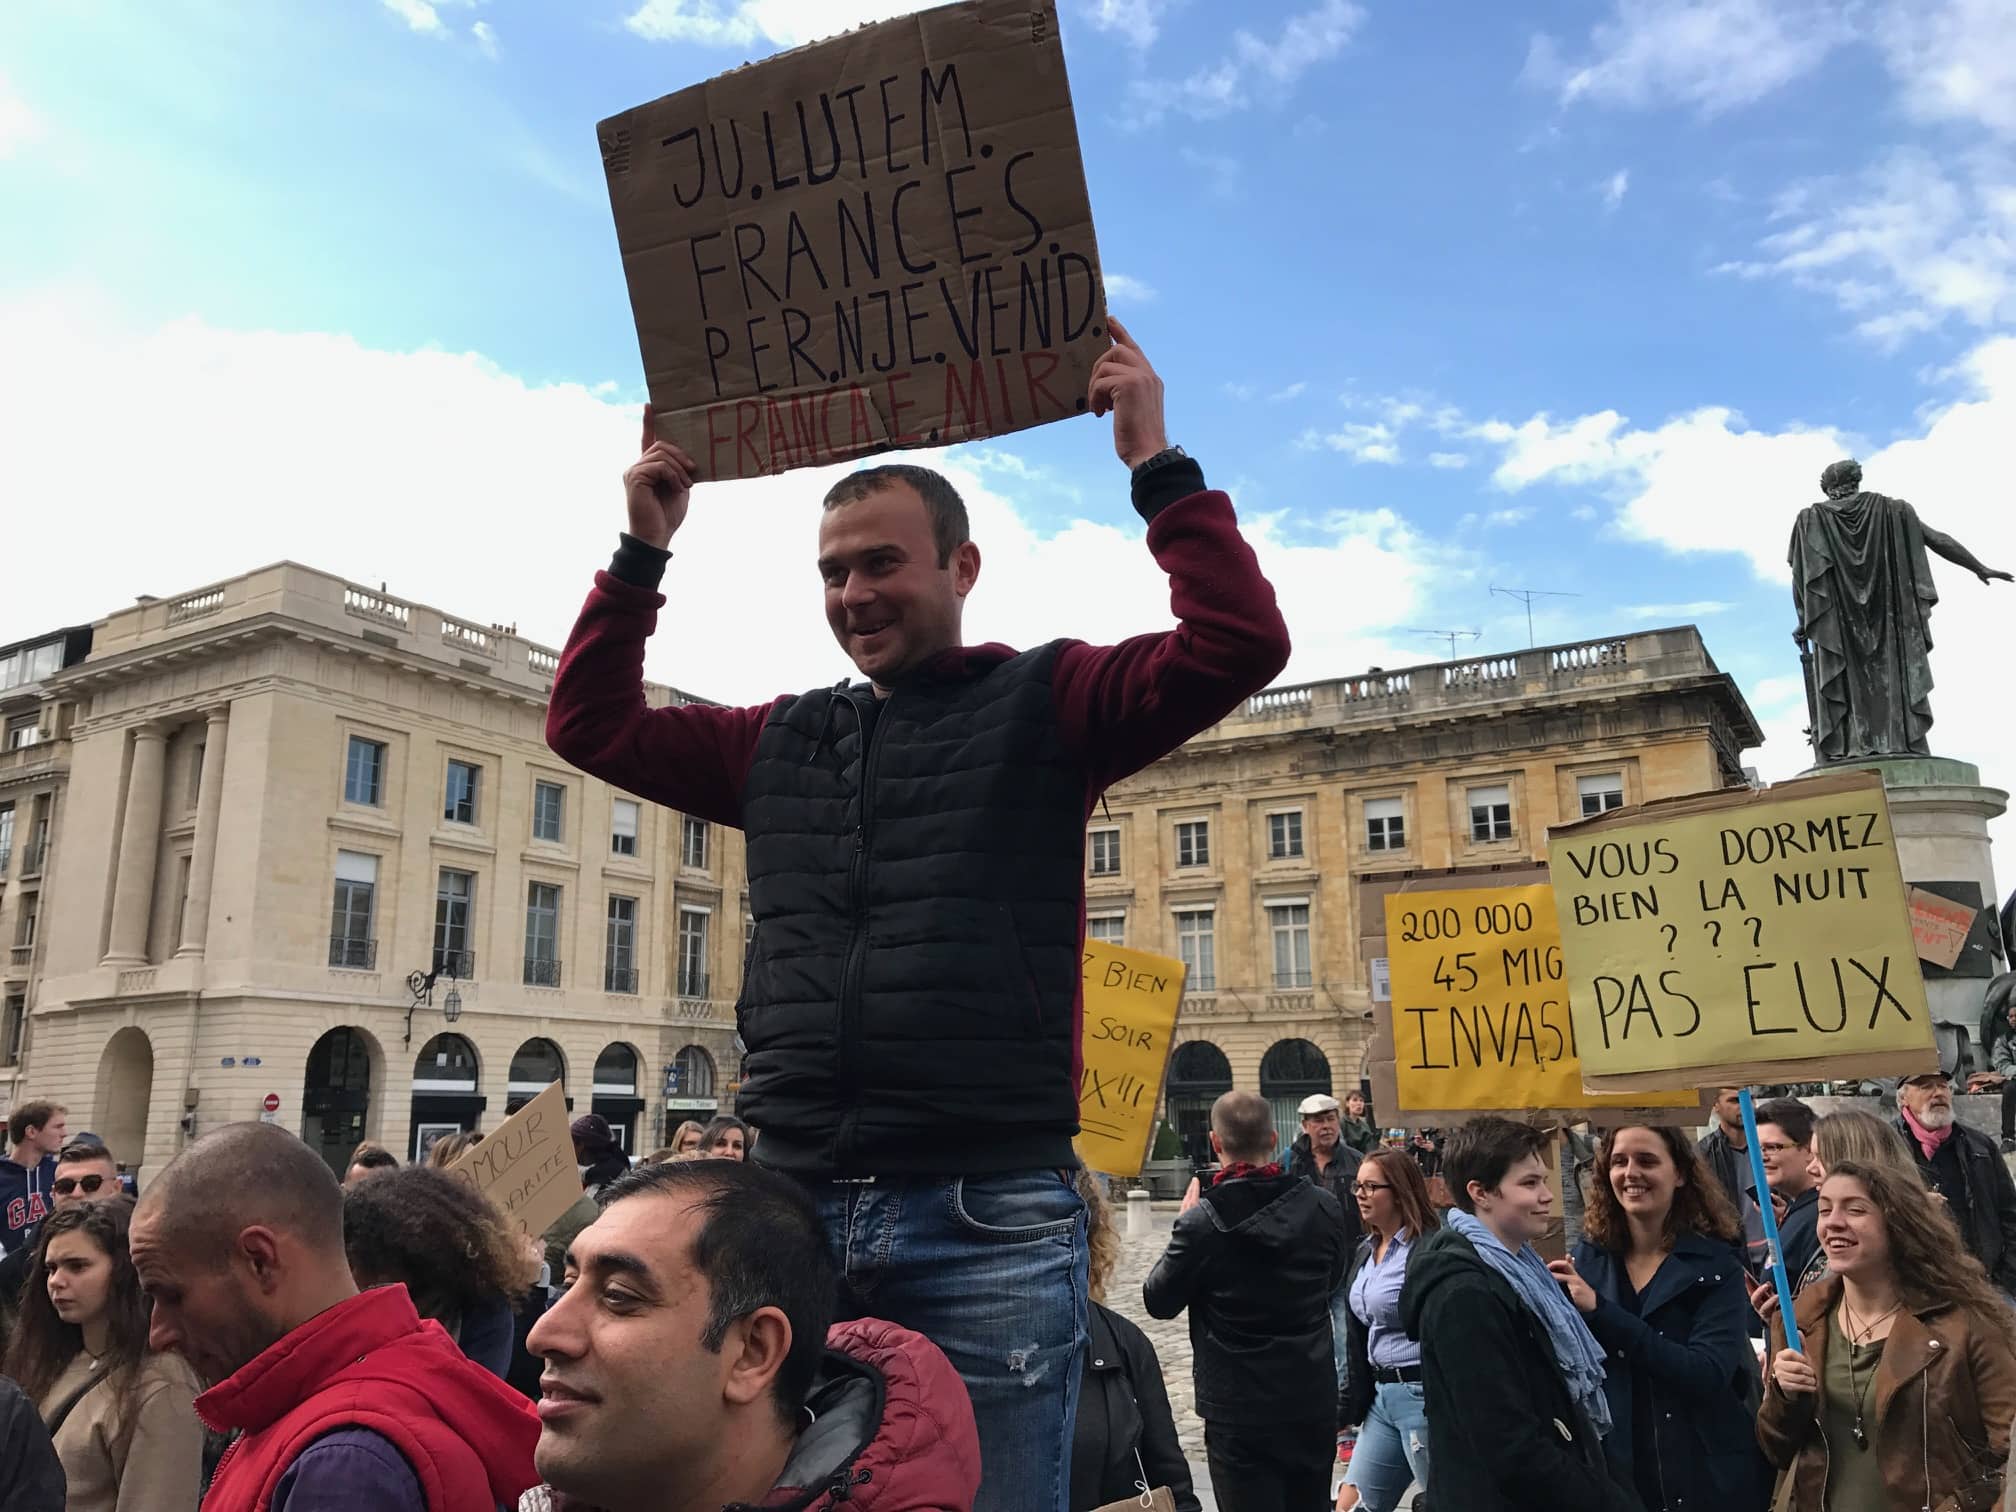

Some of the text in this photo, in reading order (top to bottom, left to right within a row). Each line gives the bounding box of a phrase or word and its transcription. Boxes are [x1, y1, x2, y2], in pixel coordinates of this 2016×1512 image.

[1566, 812, 1884, 880] VOUS DORMEZ
[1573, 867, 1870, 926] BIEN LA NUIT
[1402, 902, 1533, 942] 200 000
[1103, 960, 1168, 993] BIEN
[1433, 951, 1478, 992] 45
[1502, 945, 1563, 987] MIG
[1593, 956, 1912, 1049] PAS EUX
[1092, 1016, 1153, 1051] SOIR
